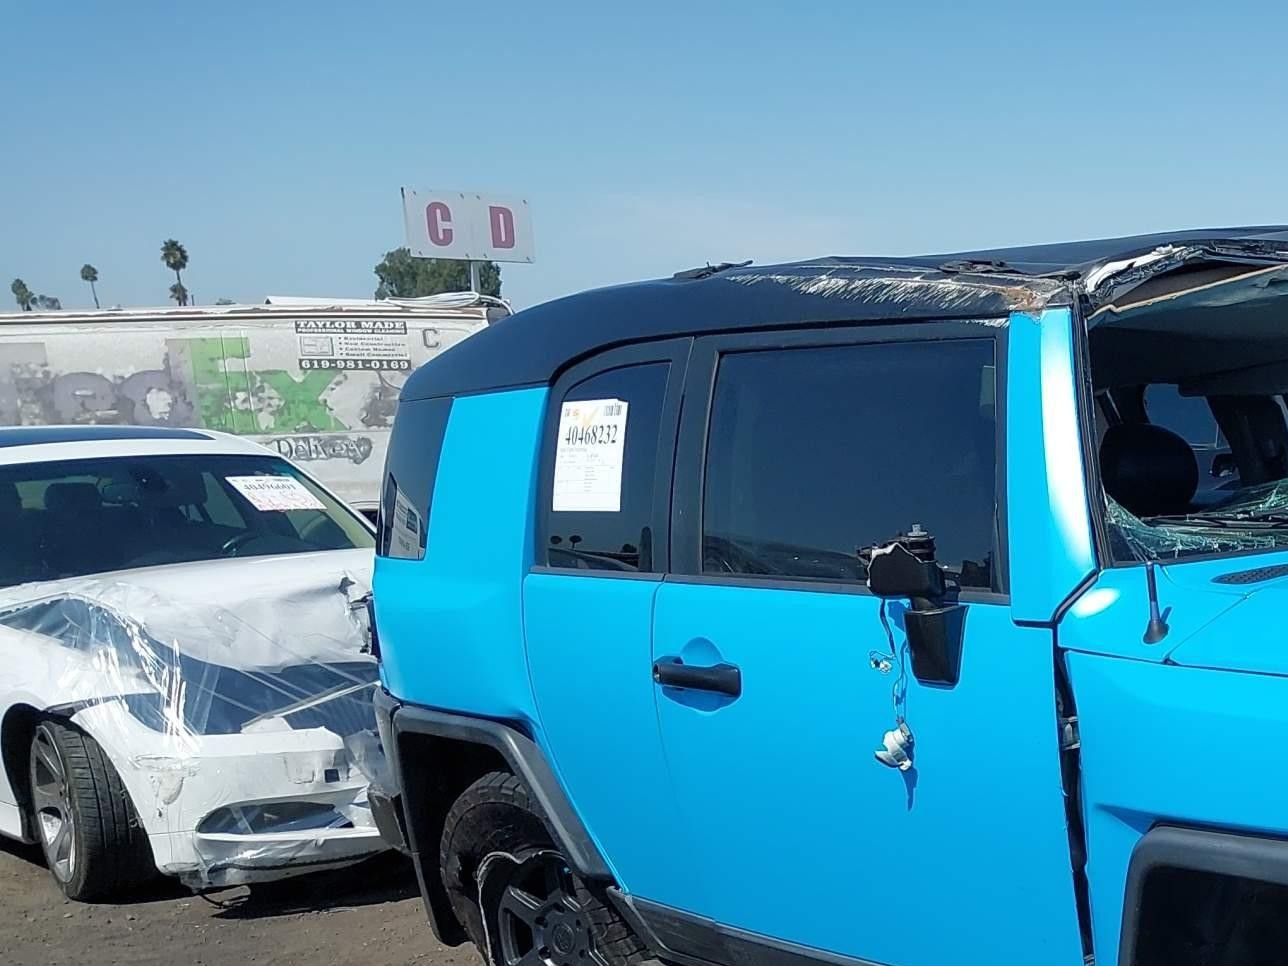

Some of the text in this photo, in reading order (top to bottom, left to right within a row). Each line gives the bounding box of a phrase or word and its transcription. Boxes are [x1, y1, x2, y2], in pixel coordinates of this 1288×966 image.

[426, 201, 515, 248] C D
[297, 321, 405, 329] TAYLOR MADE
[301, 360, 409, 369] 619-981-0169
[565, 424, 618, 446] 40468232
